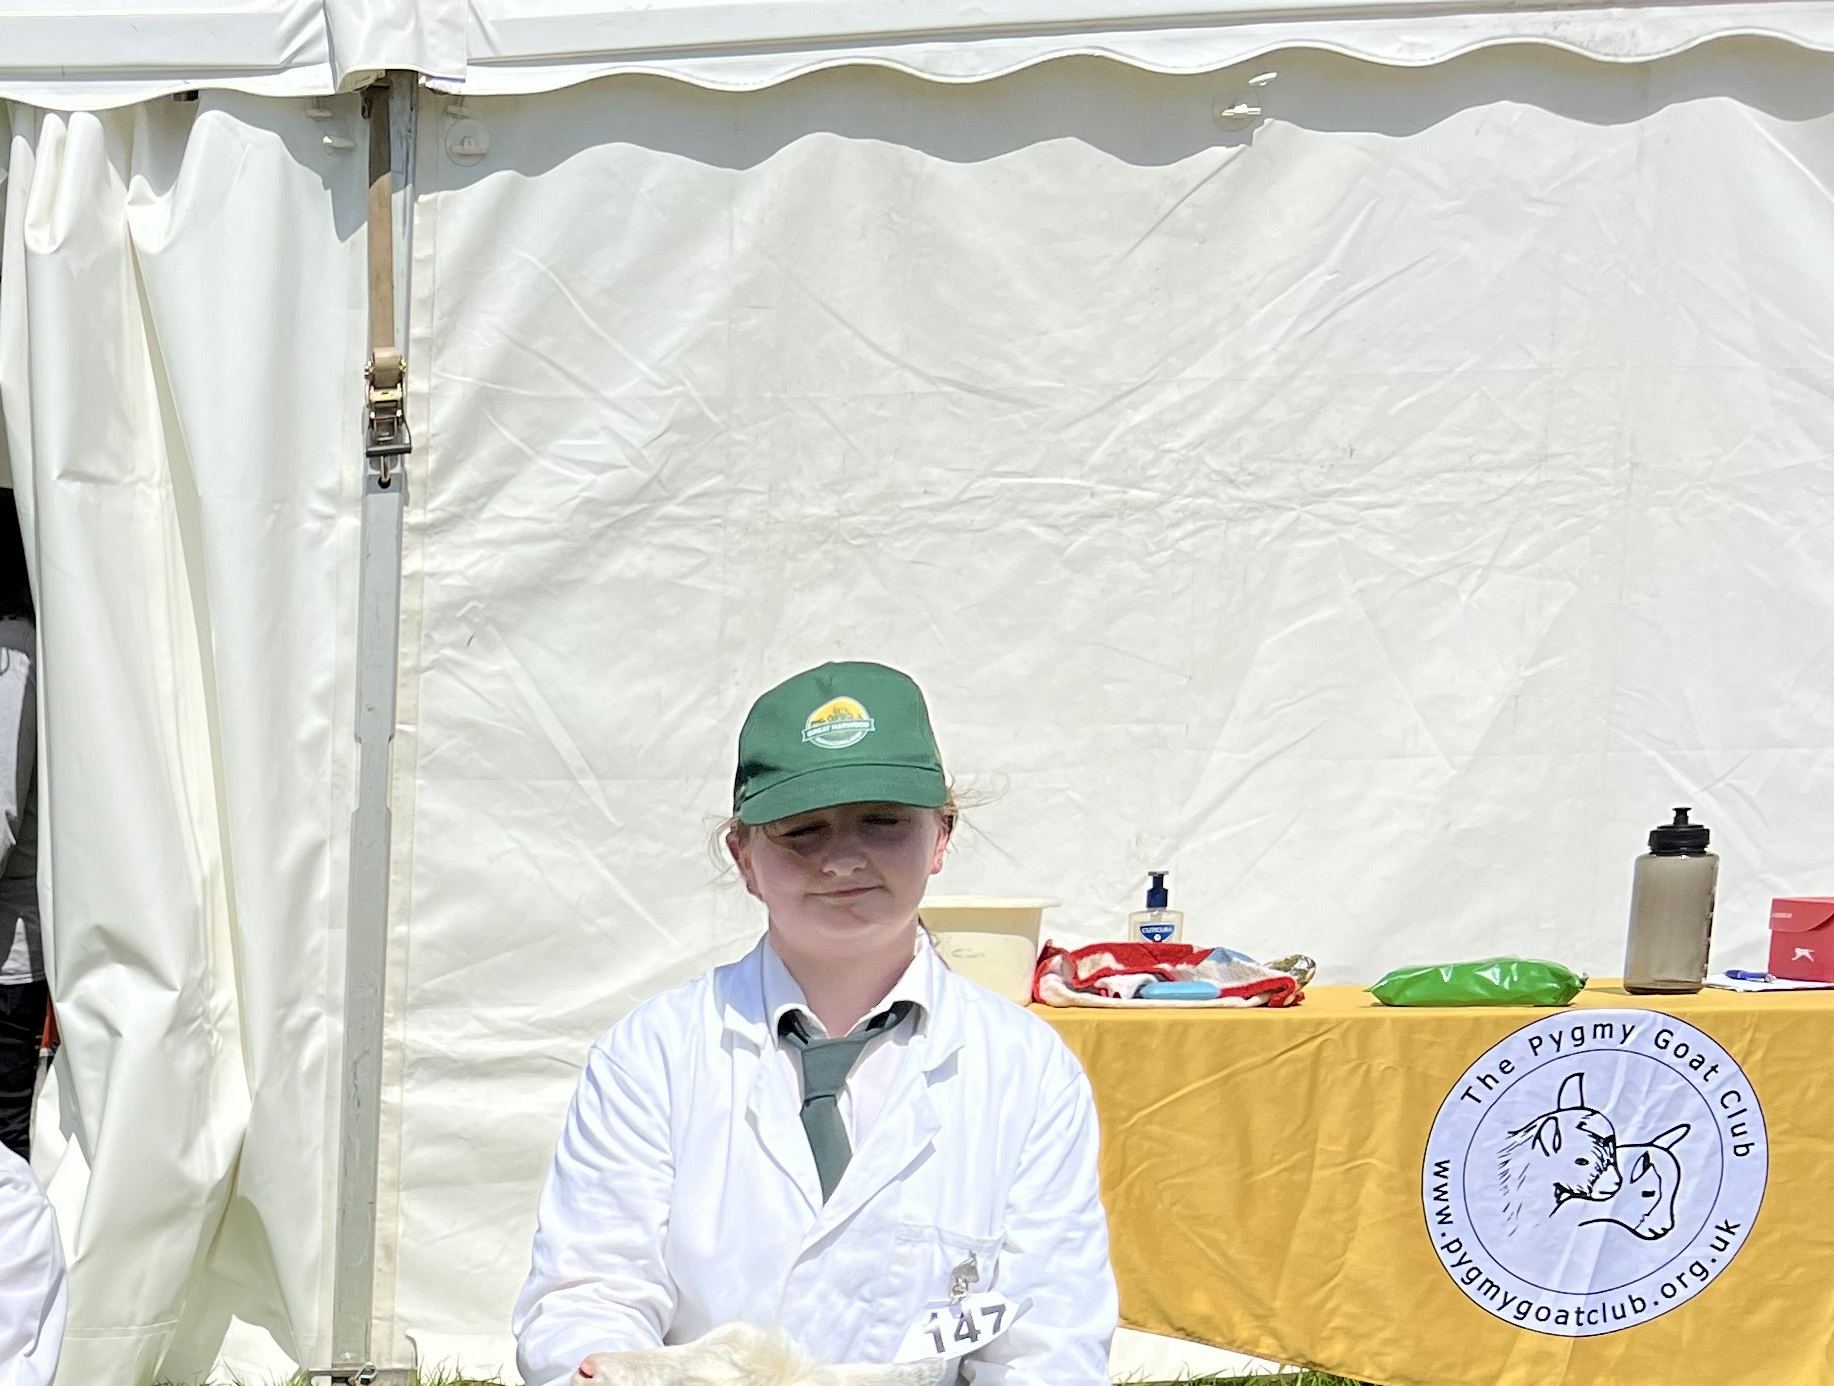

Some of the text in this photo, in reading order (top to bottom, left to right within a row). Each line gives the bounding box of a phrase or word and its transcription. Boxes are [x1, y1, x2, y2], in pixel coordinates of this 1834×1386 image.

[1461, 1021, 1755, 1158] The Pygmy Goat Club
[1432, 1158, 1742, 1328] www.pygmygoatclub.org.uk
[922, 1303, 1007, 1354] 147
